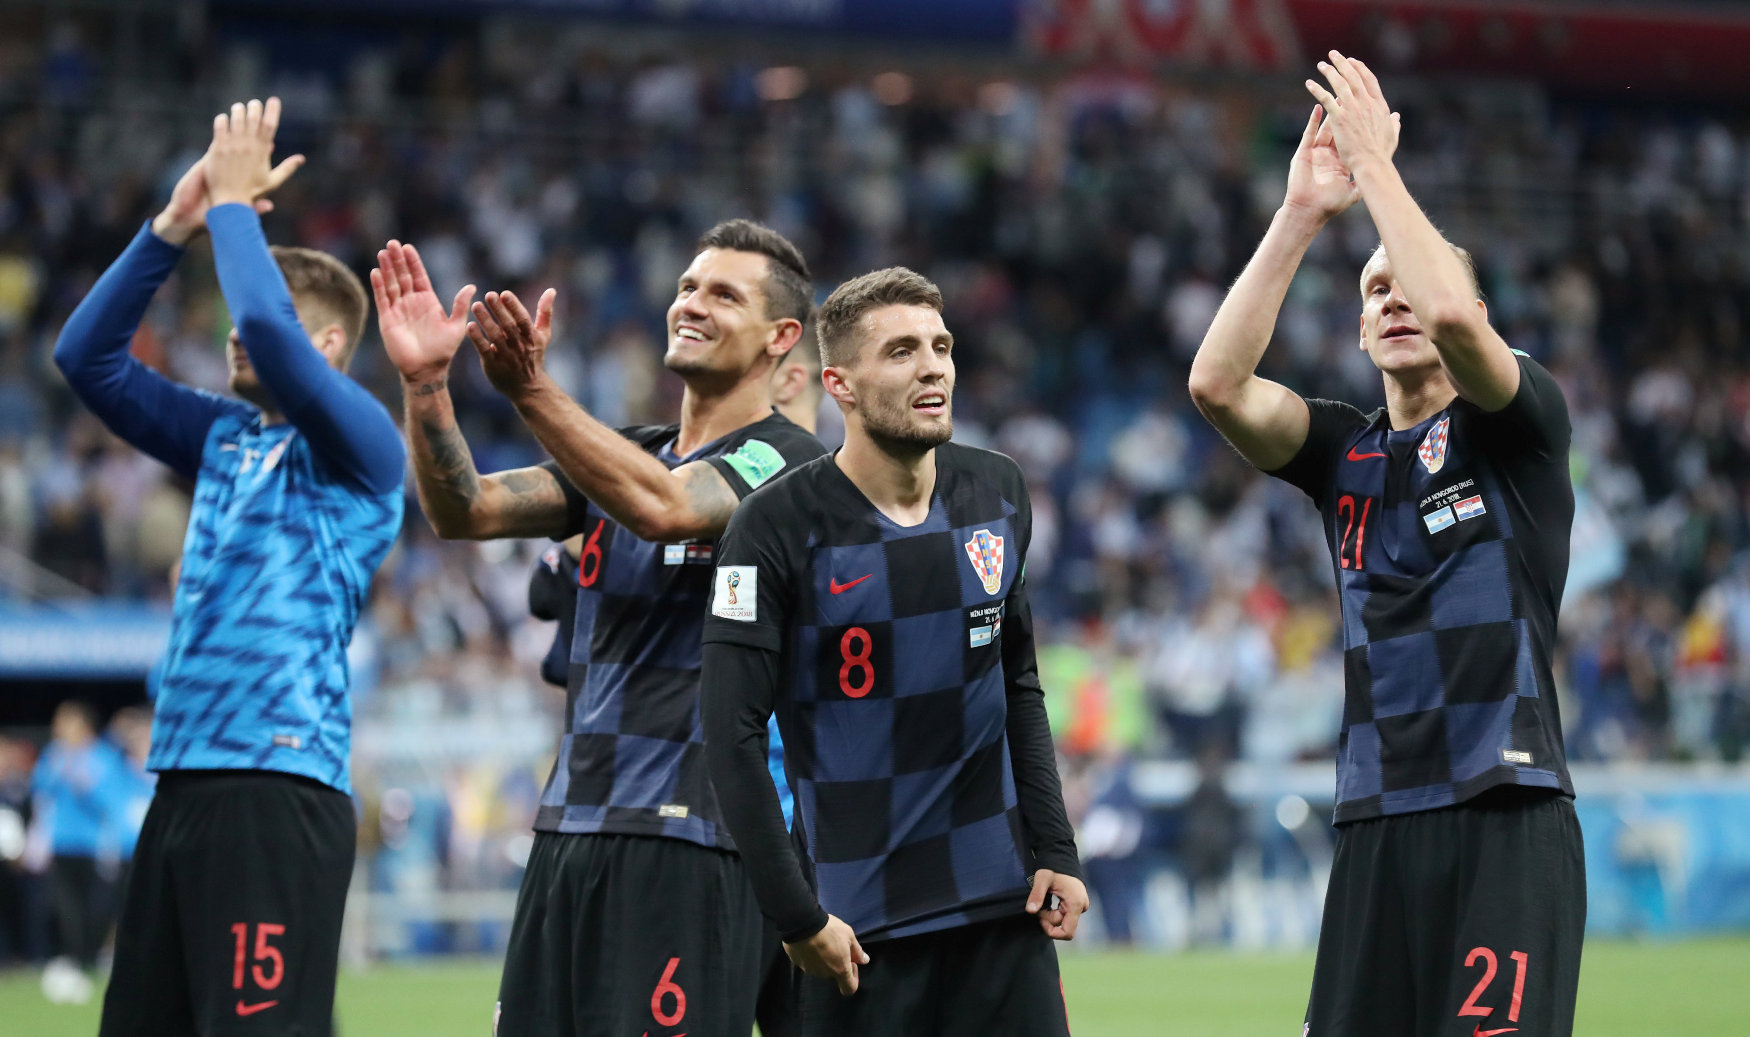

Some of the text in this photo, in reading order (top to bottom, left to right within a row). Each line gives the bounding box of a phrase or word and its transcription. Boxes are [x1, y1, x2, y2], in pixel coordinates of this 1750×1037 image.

[579, 519, 605, 588] 6
[1338, 495, 1372, 570] 21
[839, 626, 875, 698] 8
[231, 922, 286, 990] 15
[1457, 946, 1528, 1023] 21
[651, 957, 687, 1027] 6
